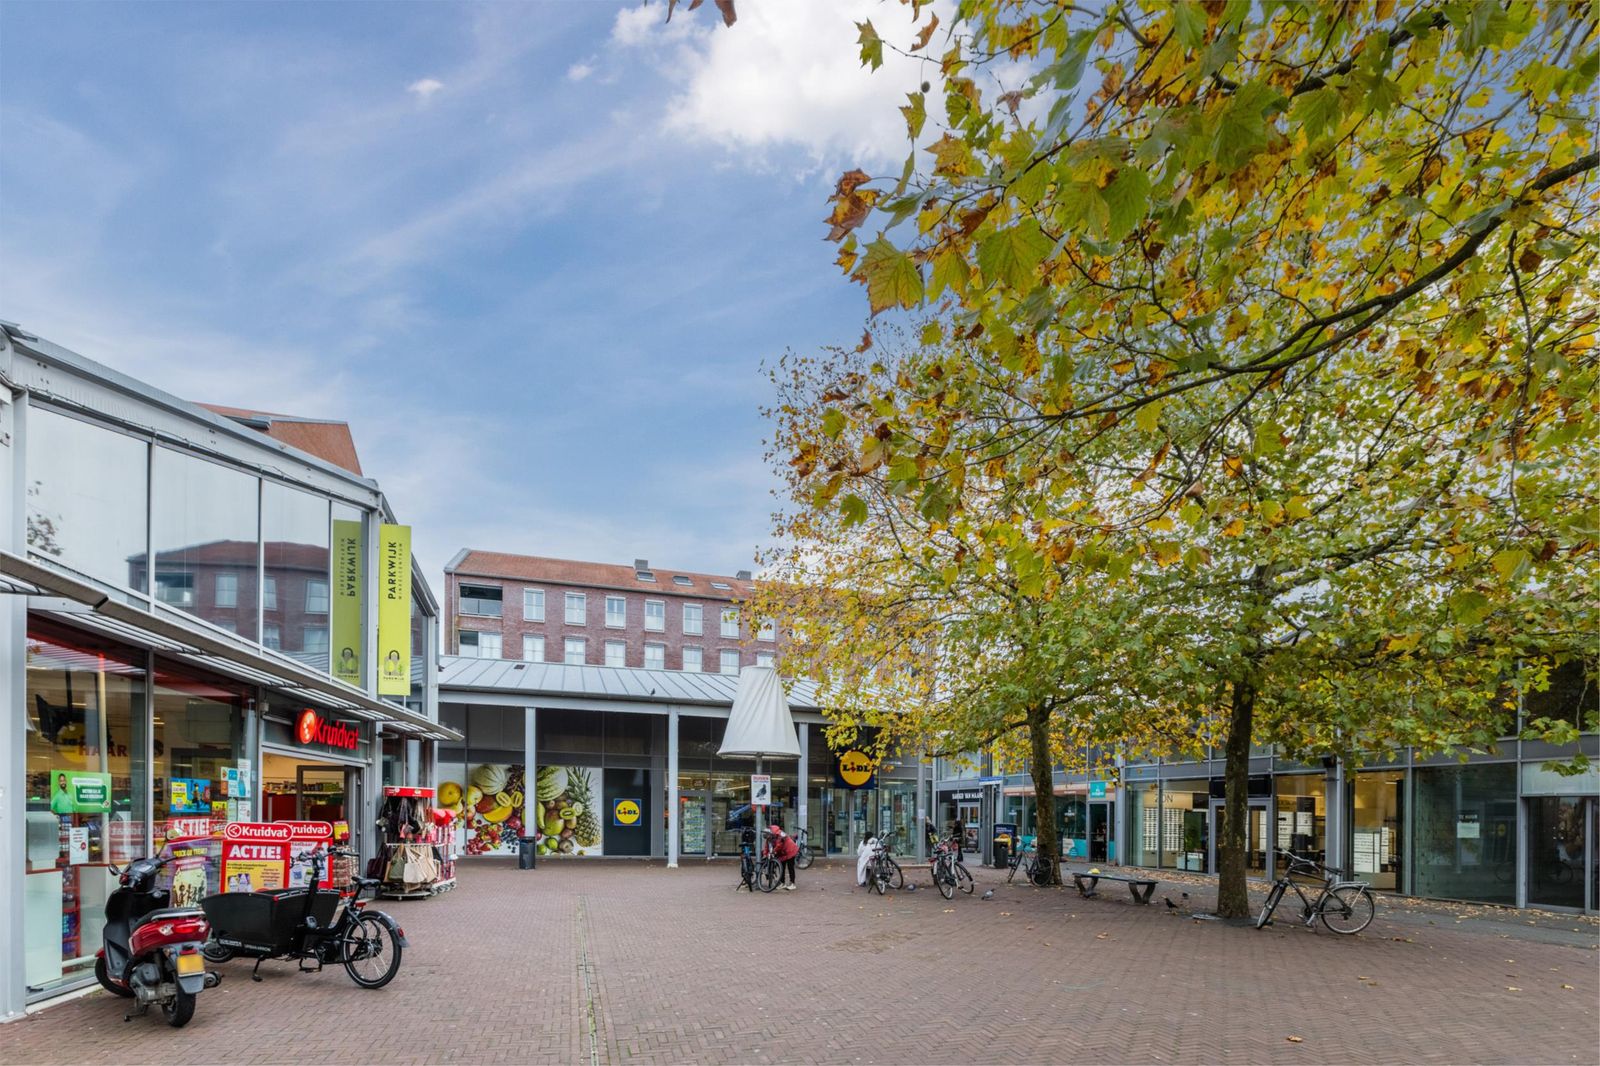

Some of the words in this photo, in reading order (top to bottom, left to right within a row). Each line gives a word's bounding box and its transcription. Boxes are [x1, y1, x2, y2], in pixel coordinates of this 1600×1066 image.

[388, 541, 397, 600] PARKWIJK
[314, 717, 359, 751] Kruidvat
[173, 818, 209, 837] ACTIE!
[241, 826, 288, 838] Kruidvat
[292, 824, 328, 834] ruidvat
[229, 844, 282, 860] ACTIE!
